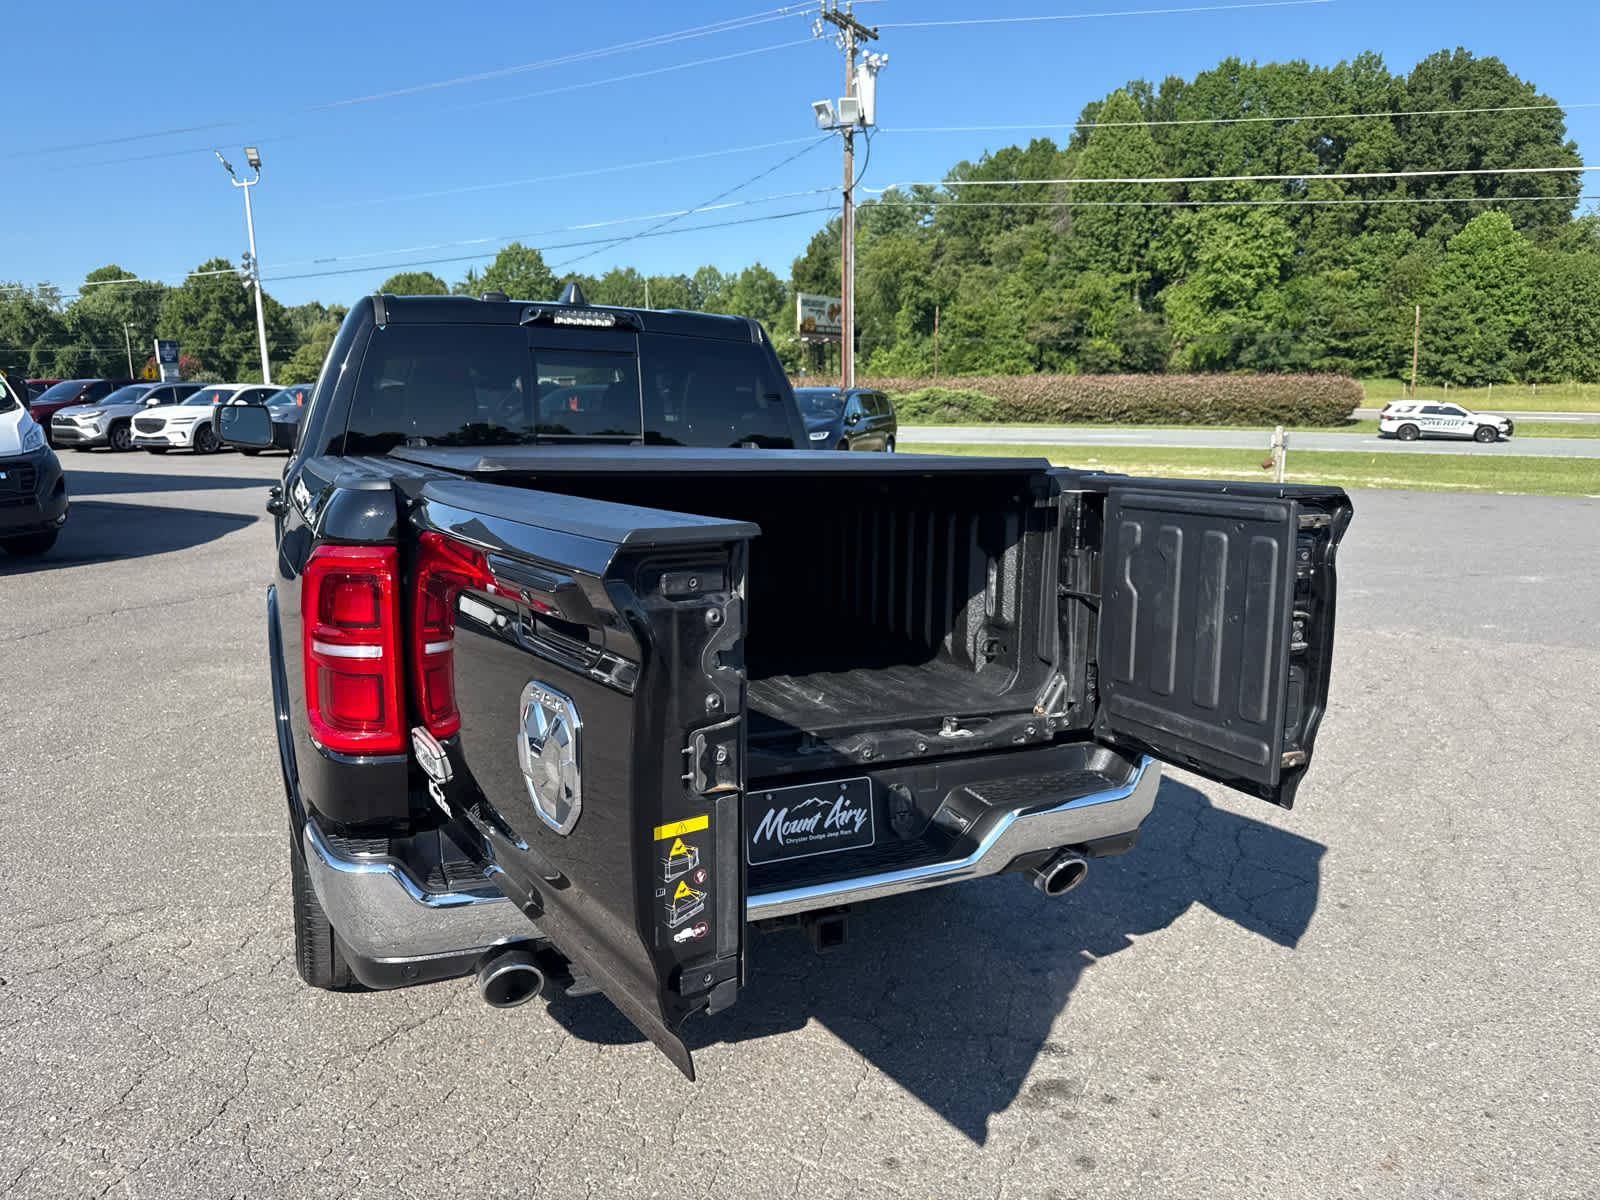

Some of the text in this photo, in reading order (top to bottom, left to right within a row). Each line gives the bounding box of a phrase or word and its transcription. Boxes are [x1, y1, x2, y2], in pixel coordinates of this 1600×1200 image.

[1420, 417, 1467, 426] SHERIFF
[753, 795, 868, 846] Mount Airy
